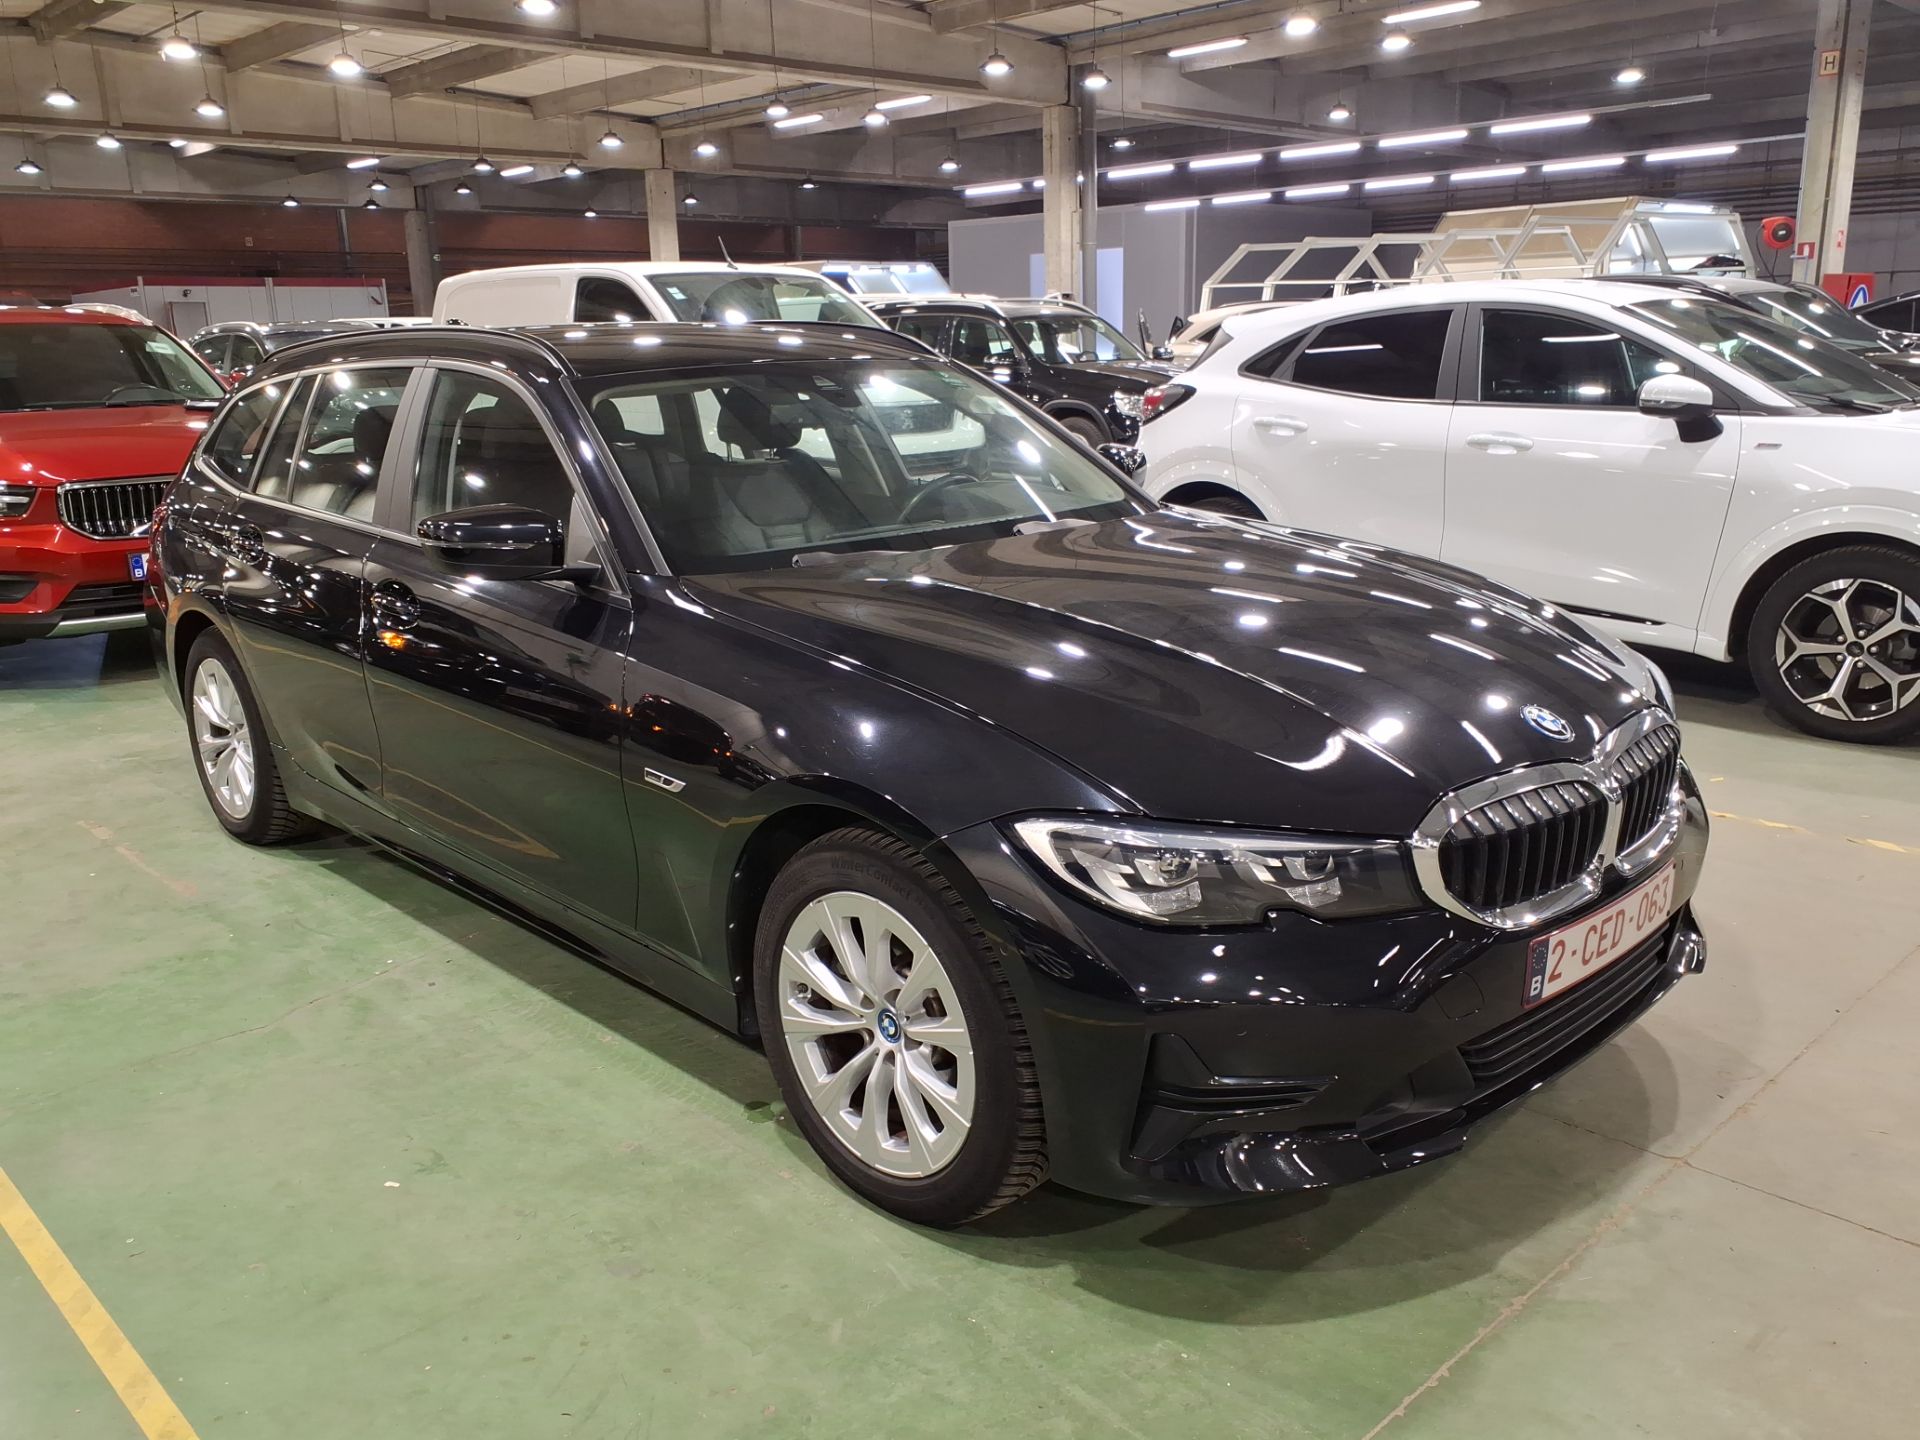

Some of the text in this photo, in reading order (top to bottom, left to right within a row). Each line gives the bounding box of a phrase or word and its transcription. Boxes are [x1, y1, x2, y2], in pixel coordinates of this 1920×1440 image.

[1824, 55, 1836, 71] H
[1547, 874, 1670, 984] 2-CED-063
[1529, 975, 1542, 997] B
